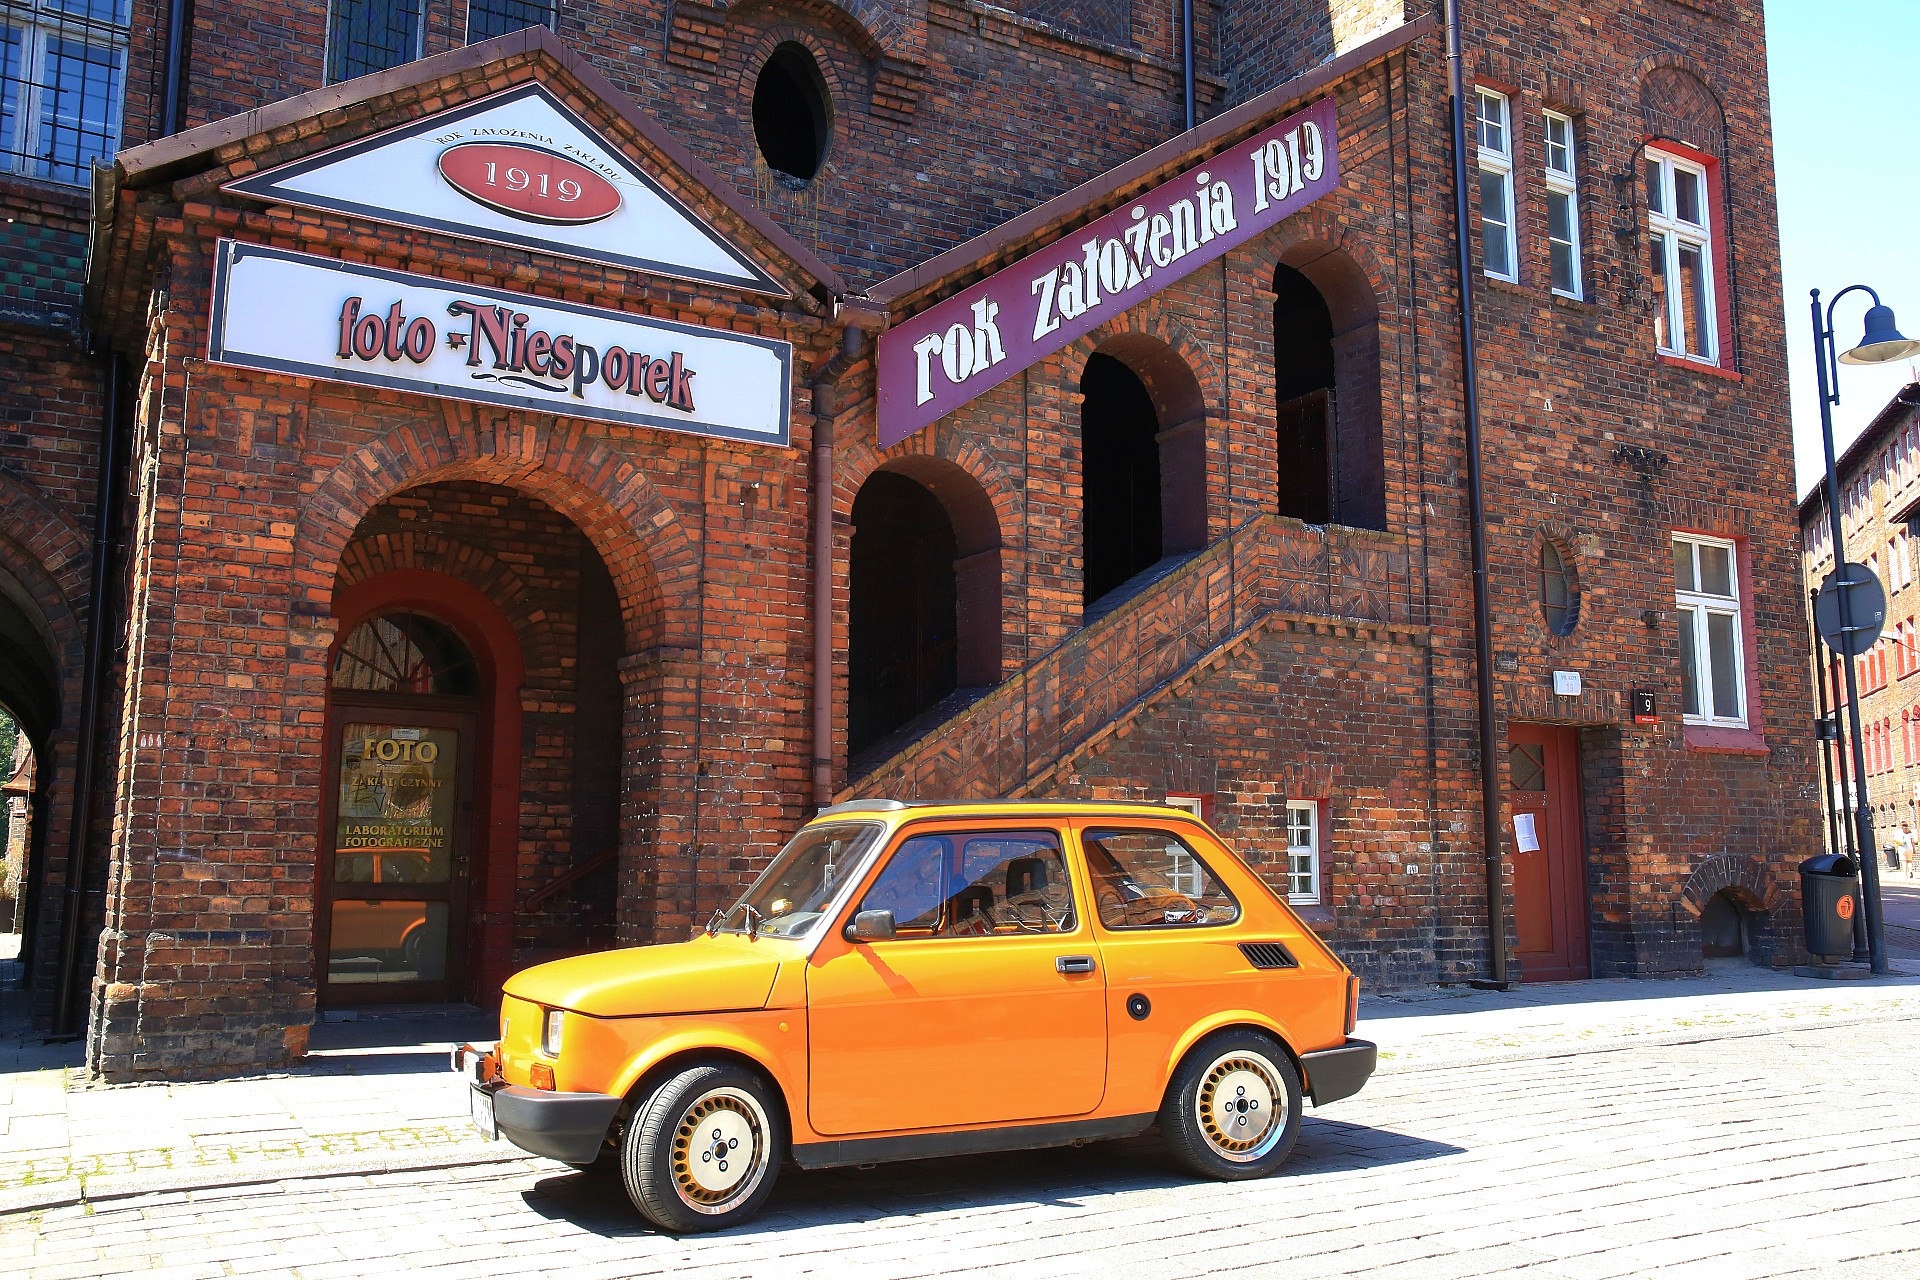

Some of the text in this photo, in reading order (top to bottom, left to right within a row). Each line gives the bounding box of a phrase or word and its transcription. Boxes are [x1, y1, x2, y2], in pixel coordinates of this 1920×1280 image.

[436, 128, 622, 180] ROK ZAŁOŻENIA ZAKŁADU
[484, 162, 583, 202] 1919
[912, 120, 1326, 408] rok założenia 1919
[336, 296, 696, 414] foto Niesporek
[1645, 699, 1651, 712] 9
[364, 739, 437, 762] FOTO
[401, 777, 443, 789] CZYNNY
[345, 825, 444, 836] LABORATORIUM
[345, 838, 444, 848] FOTOGRAFICZNE
